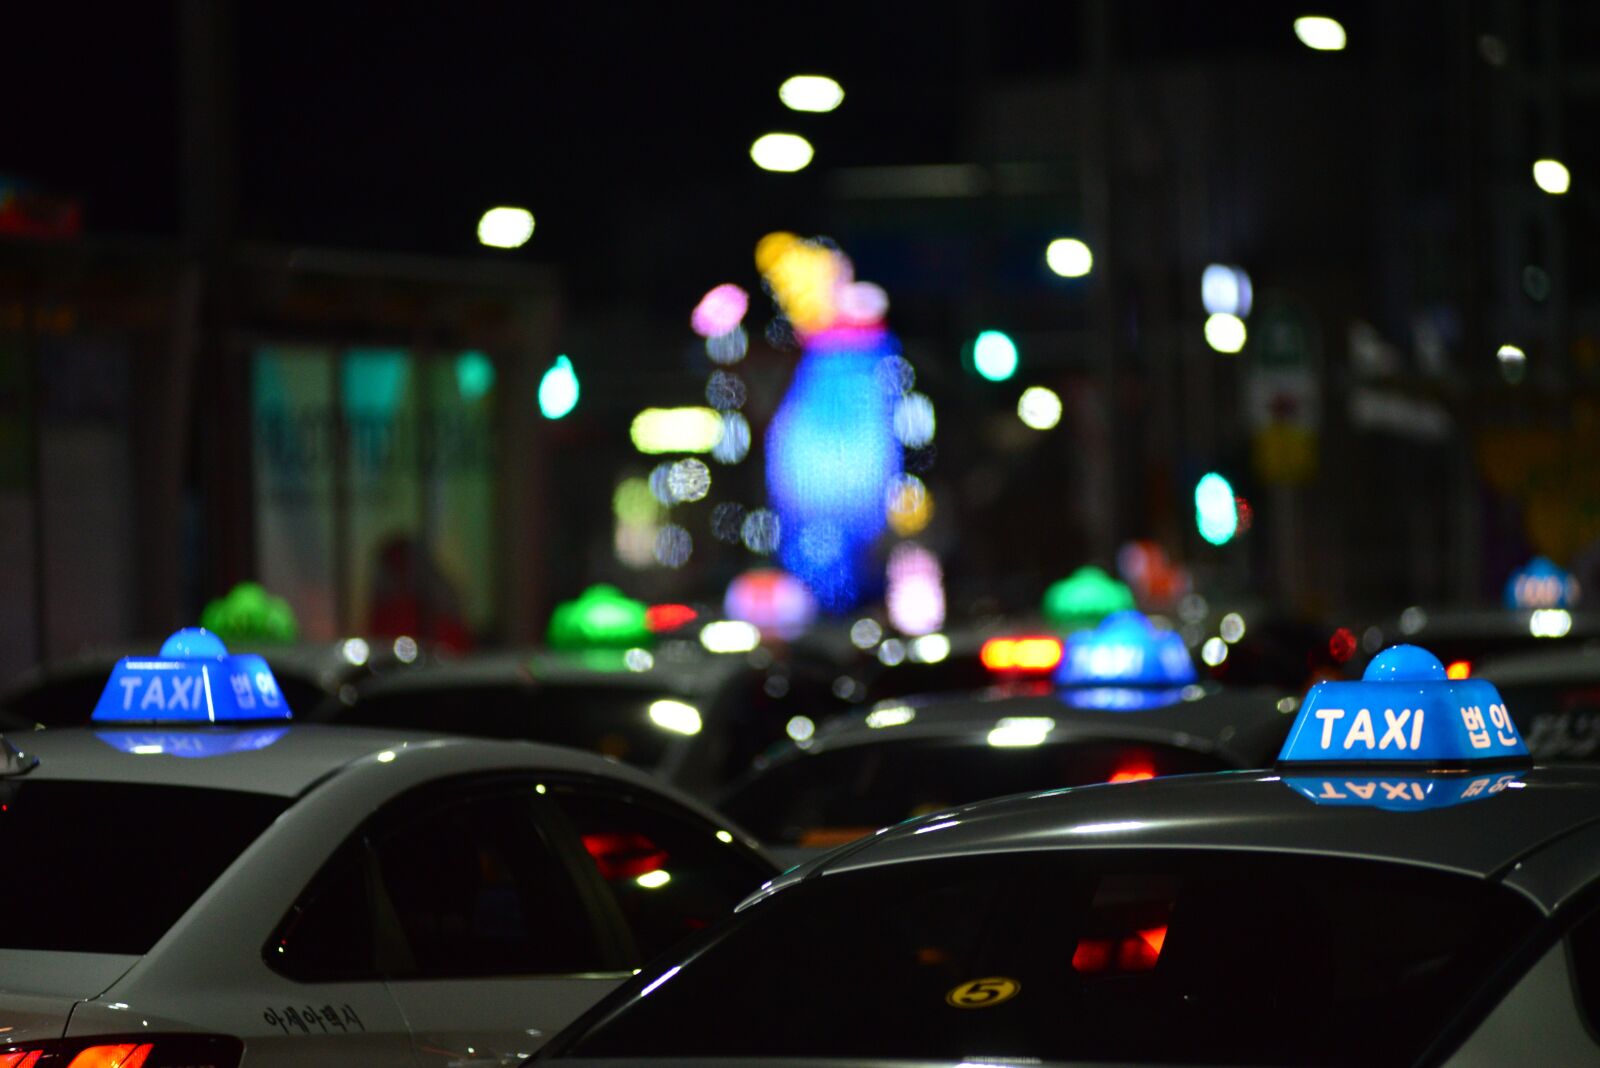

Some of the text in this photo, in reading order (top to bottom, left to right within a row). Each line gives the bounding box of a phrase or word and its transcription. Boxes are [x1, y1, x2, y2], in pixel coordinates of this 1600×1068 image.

[119, 676, 204, 711] TAXI
[1315, 708, 1425, 750] TAXI
[1460, 703, 1517, 749] 법인
[961, 982, 1004, 1004] 5
